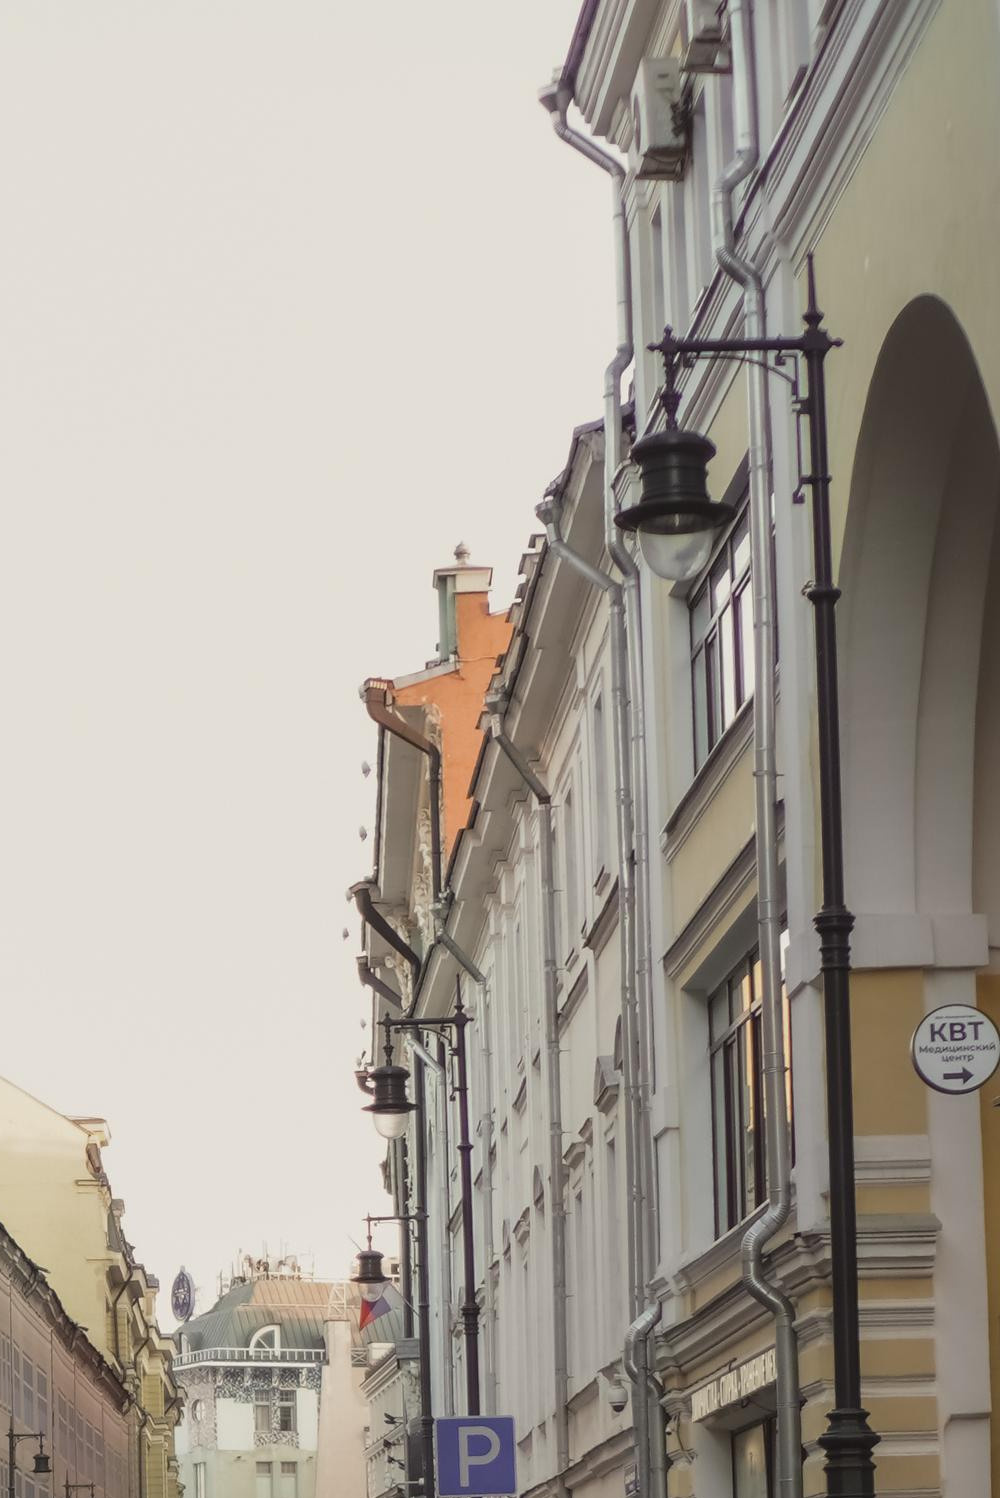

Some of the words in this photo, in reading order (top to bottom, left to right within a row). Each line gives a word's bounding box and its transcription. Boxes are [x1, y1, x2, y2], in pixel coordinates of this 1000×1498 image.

[930, 1021, 984, 1042] КВТ
[919, 1042, 996, 1054] Медицинский
[941, 1054, 974, 1062] центр
[458, 1426, 501, 1488] P
